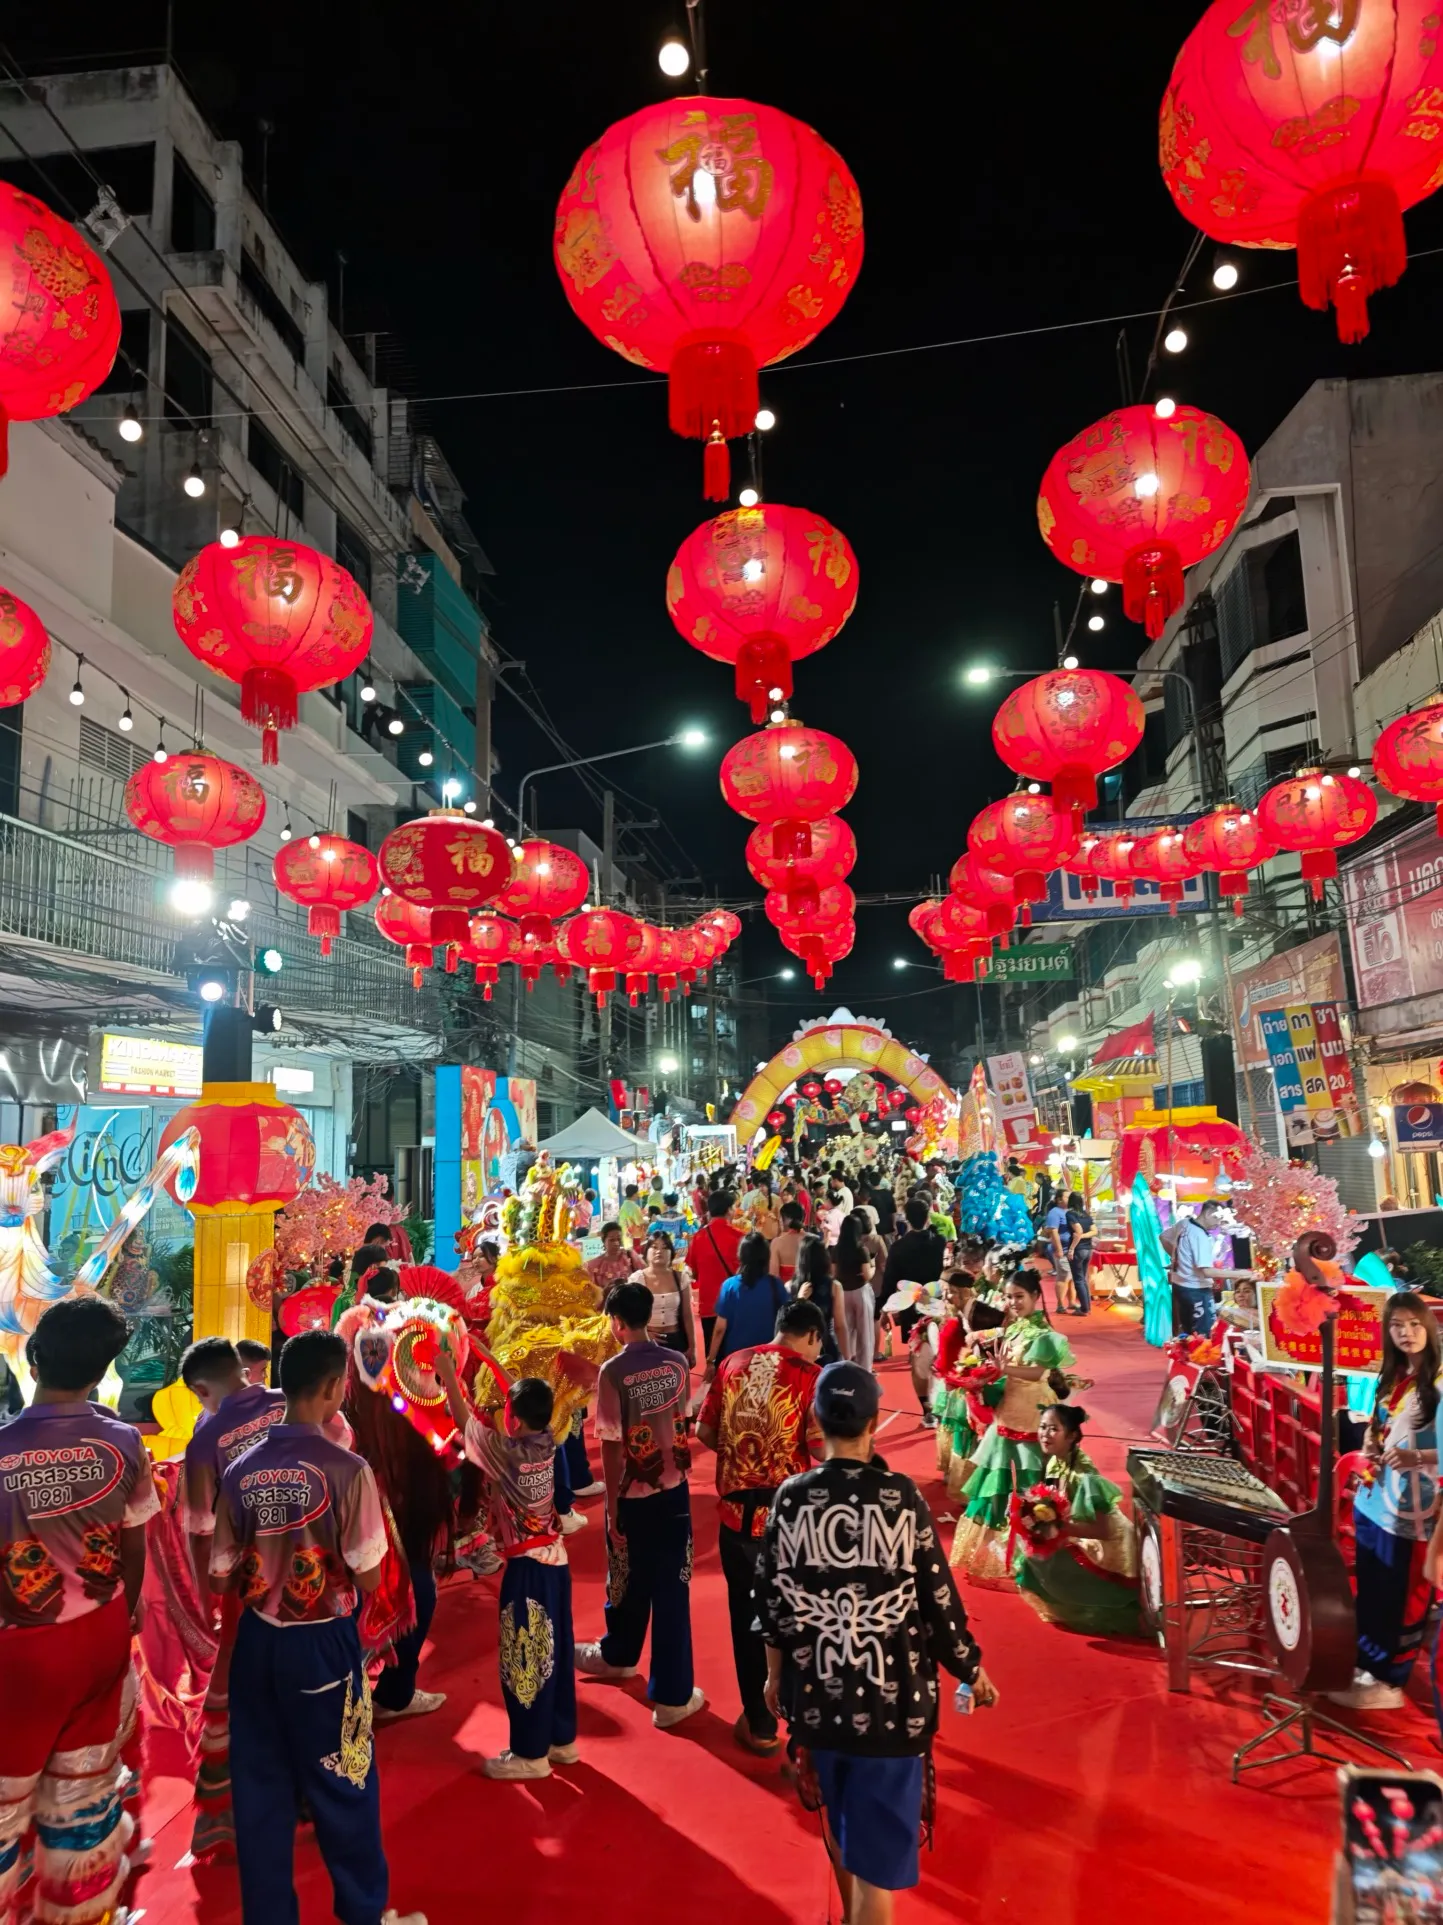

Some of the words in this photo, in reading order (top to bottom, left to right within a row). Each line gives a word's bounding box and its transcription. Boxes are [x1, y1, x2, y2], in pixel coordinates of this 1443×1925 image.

[656, 110, 774, 223] 福
[445, 832, 495, 878] 福
[1263, 1016, 1288, 1034] ถ่าย
[1291, 1013, 1311, 1030] กา
[1315, 1007, 1337, 1024] ชา
[1297, 1040, 1317, 1062] แฟ
[1321, 1039, 1343, 1057] นม
[1273, 1052, 1294, 1066] เอก
[1280, 1083, 1303, 1099] สาร
[1306, 1077, 1326, 1094] สด
[1412, 1131, 1433, 1139] pepsi
[1192, 1301, 1205, 1318] 5
[633, 1365, 675, 1383] TOYOTA
[628, 1374, 678, 1399] นครสวรรค์
[640, 1392, 665, 1409] 1981
[231, 1408, 285, 1440] TOYOTA
[22, 1446, 98, 1467] TOYOTA
[4, 1458, 105, 1492] นครสวรรค์
[27, 1486, 73, 1509] 1981
[531, 1480, 552, 1500] 1981
[256, 1506, 287, 1526] 981
[776, 1503, 919, 1573] MCM
